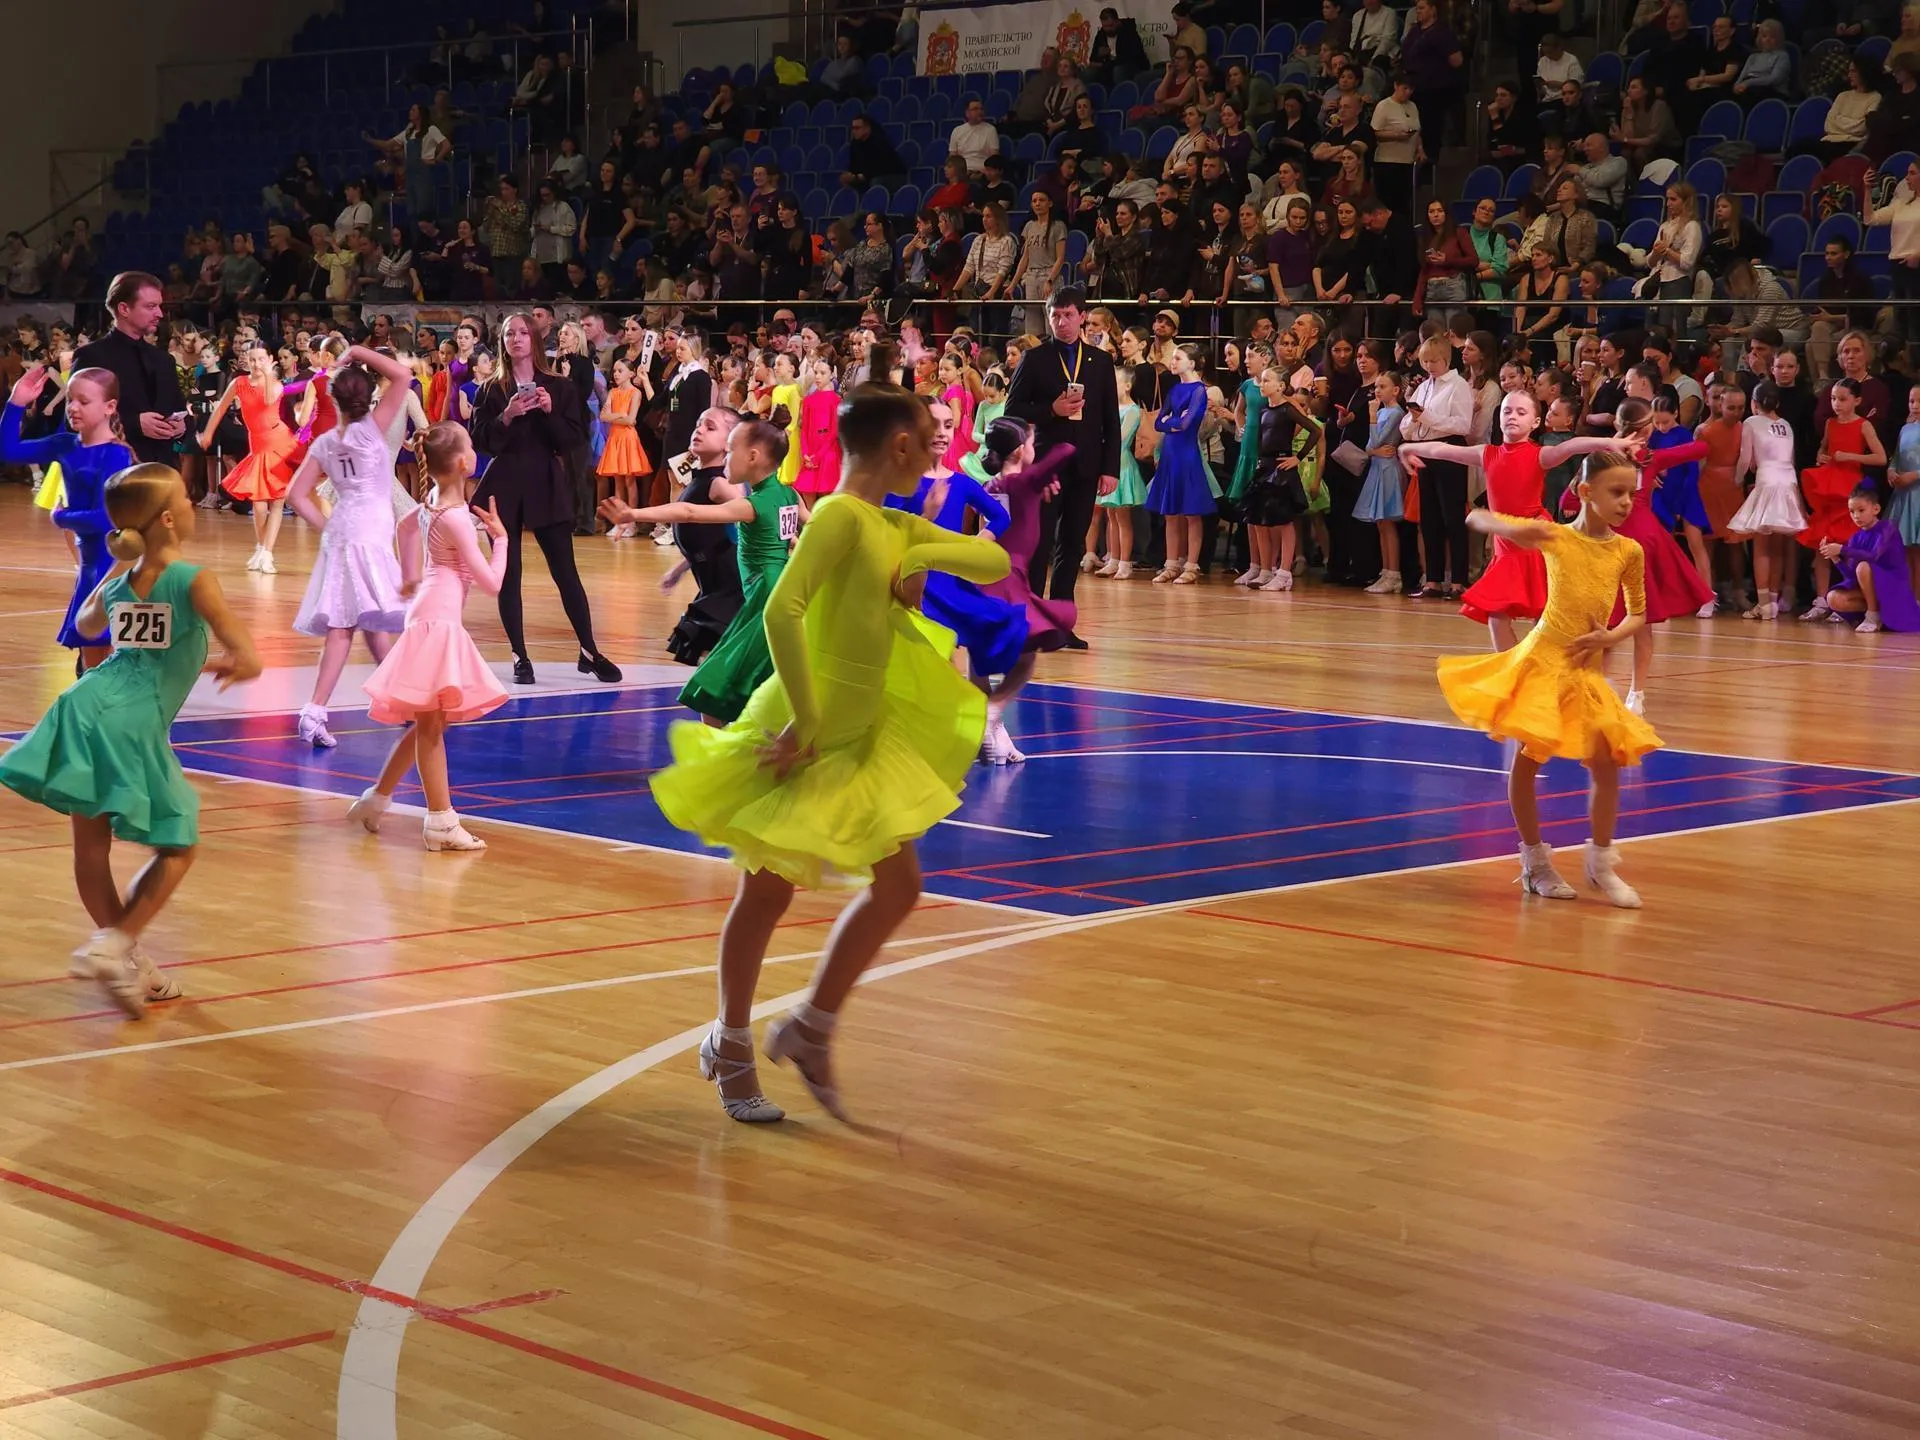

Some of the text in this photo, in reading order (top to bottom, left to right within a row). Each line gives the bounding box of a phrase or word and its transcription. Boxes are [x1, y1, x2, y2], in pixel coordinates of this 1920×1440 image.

[965, 31, 1033, 46] ПРАВИТЕЛЬСТВО
[963, 44, 1021, 59] МОСКОВСКОЙ
[961, 61, 999, 72] ОБЛАСТИ
[645, 335, 653, 348] B
[642, 354, 648, 365] 3
[1770, 424, 1787, 436] 113
[338, 457, 356, 478] 71
[118, 612, 166, 643] 225
